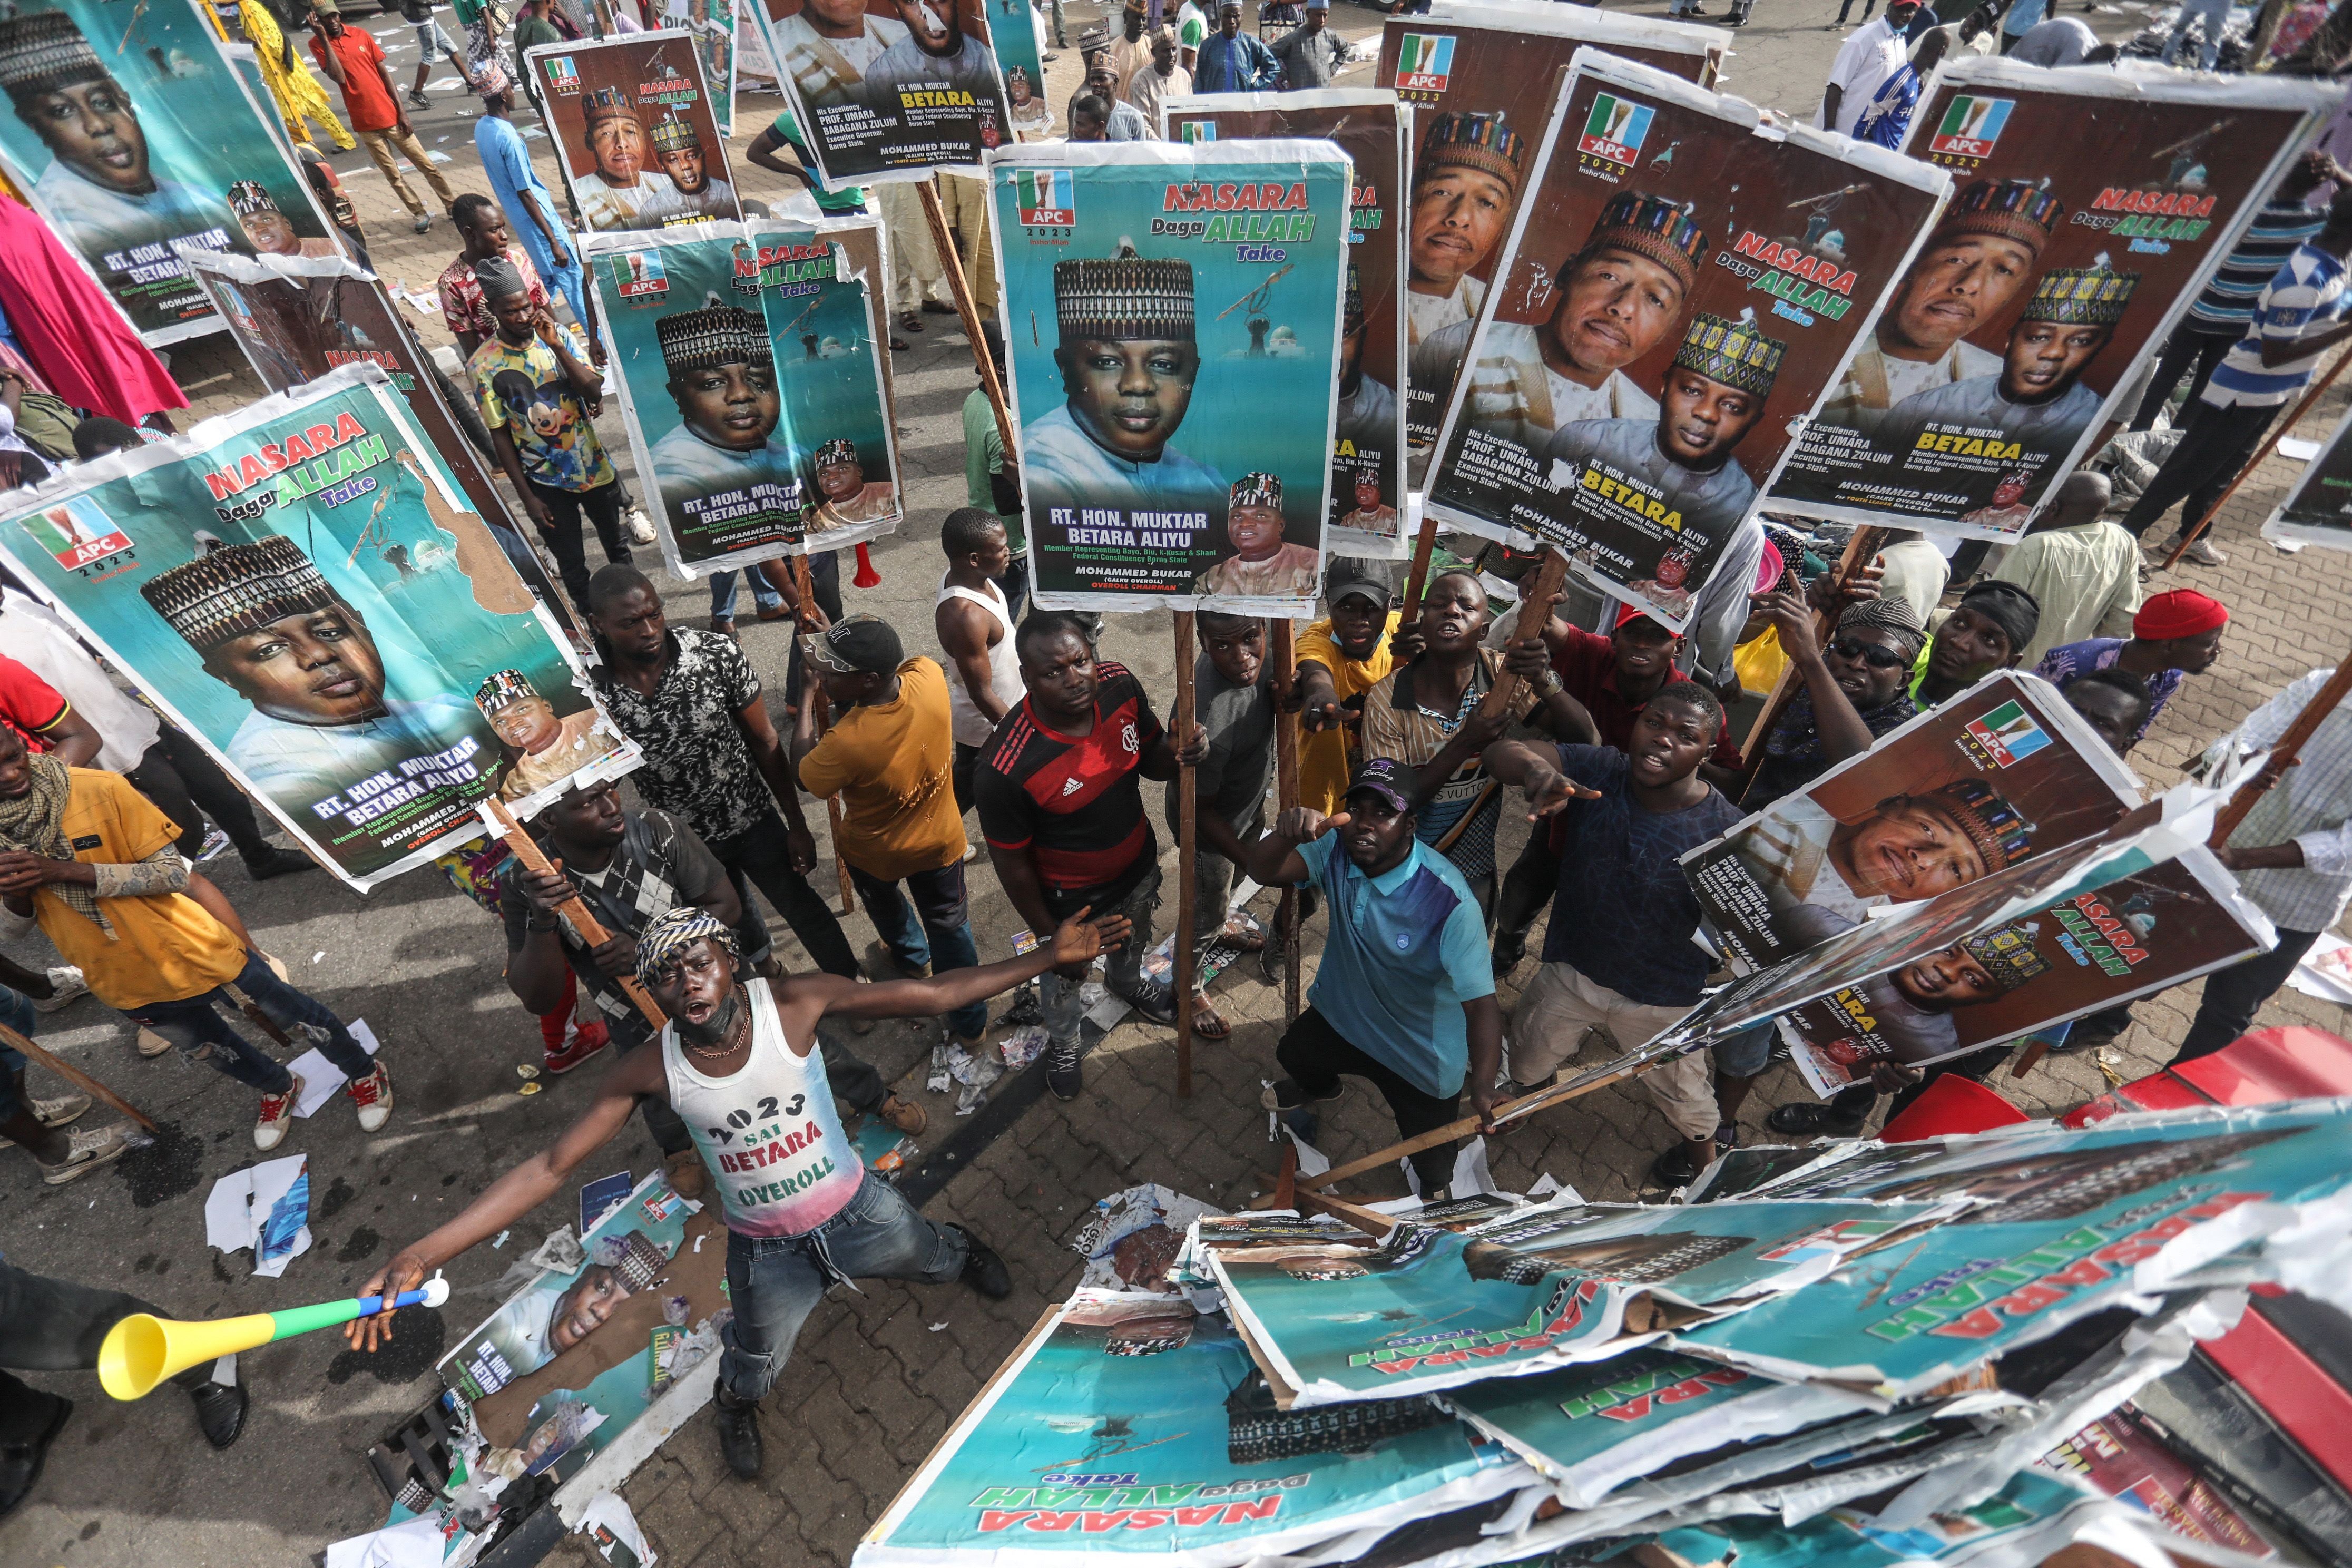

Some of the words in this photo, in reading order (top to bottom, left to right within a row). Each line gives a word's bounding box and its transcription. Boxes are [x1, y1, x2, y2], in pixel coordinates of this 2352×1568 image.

[640, 79, 692, 95] NASARA
[1408, 76, 1437, 87] APC
[639, 96, 658, 104] Daga
[659, 90, 697, 105] ALLAH
[900, 91, 975, 108] BETARA
[1399, 91, 1439, 101] 2023
[819, 114, 844, 125] PROF.
[846, 110, 875, 122] UMARA
[827, 104, 862, 114] Excellency,
[822, 121, 868, 135] BABAGANA
[869, 117, 897, 128] ZULUM
[880, 143, 937, 155] MOHAMMED
[1592, 141, 1626, 160] APC
[1944, 139, 1982, 153] APC
[1580, 154, 1626, 175] 2023
[1931, 154, 1979, 168] 2023
[1579, 166, 1618, 184] Insha'Allah
[1163, 183, 1308, 211] NASARA
[2091, 188, 2217, 217] NASARA
[1033, 211, 1063, 223] APC
[1151, 218, 1203, 237] Daga
[1202, 214, 1316, 242] ALLAH
[2070, 211, 2119, 230] Daga
[2109, 215, 2211, 241] ALLAH
[1027, 228, 1071, 237] 2023
[104, 253, 132, 270] RT.
[130, 244, 171, 263] HON.
[1236, 244, 1287, 262] Take
[1733, 231, 1857, 296] NASARA
[759, 260, 836, 287] ALLAH
[631, 281, 658, 293] APC
[781, 282, 820, 299] Take
[1715, 251, 1760, 279] Daga
[1751, 270, 1852, 321] ALLAH
[626, 293, 667, 304] 2023
[1771, 300, 1814, 327] Take
[1468, 429, 1482, 439] His
[1483, 433, 1528, 456] Excellency,
[1828, 435, 1870, 449] UMARA
[1925, 423, 1937, 432] RT.
[1940, 424, 1962, 435] HON.
[1964, 428, 2003, 439] MUKTAR
[204, 411, 367, 501] NASARA
[1359, 450, 1380, 459] ALIYU
[1464, 438, 1495, 456] PROF.
[1499, 448, 1539, 473] UMARA
[1851, 450, 1893, 464] ZULUM
[1915, 433, 2021, 459] BETARA
[2021, 453, 2049, 463] ALIYU
[214, 492, 274, 522] Daga
[277, 434, 390, 509] ALLAH
[1454, 468, 1477, 482] Borno
[1479, 477, 1502, 490] State.
[1457, 460, 1495, 478] Executive
[1497, 474, 1533, 495] Governor,
[1460, 449, 1521, 478] BABAGANA
[1522, 471, 1561, 495] ZULUM
[1589, 459, 1601, 471] RT.
[1604, 466, 1624, 482] HON.
[1626, 476, 1664, 501] MUKTAR
[319, 477, 377, 509] Take
[683, 499, 707, 514] RT.
[710, 490, 748, 507] HON.
[751, 478, 802, 498] MUKTAR
[701, 502, 758, 524] BETARA
[762, 498, 800, 512] ALIYU
[1051, 508, 1076, 524] RT.
[1082, 509, 1125, 527] HON.
[1131, 512, 1207, 528] MUKTAR
[1571, 500, 1590, 513] Borno
[1590, 509, 1606, 521] State
[1581, 496, 1598, 508] Shani
[1599, 506, 1622, 521] Federal
[1622, 517, 1663, 542] Constituency
[1582, 469, 1681, 533] BETARA
[1682, 528, 1708, 546] ALIYU
[1577, 487, 1603, 503] Member
[1604, 499, 1644, 524] Representing
[1677, 537, 1701, 553] K-Kusar
[1068, 528, 1135, 546] BETARA
[1141, 532, 1191, 547] ALIYU
[1511, 504, 1588, 544] MOHAMMED
[1589, 542, 1634, 569] BUKAR
[76, 538, 116, 562] APC
[1075, 546, 1121, 554] Representing
[1101, 554, 1145, 563] Constituency
[79, 551, 135, 577] 2023
[1075, 567, 1148, 577] MOHAMMED
[803, 645, 813, 653] M
[1954, 739, 1984, 771] Insha'Allah
[1960, 733, 1996, 768] 2023
[1977, 733, 2006, 757] APC
[313, 796, 350, 819] RT.
[347, 771, 403, 803] HON.
[399, 737, 478, 777] MUKTAR
[1360, 769, 1394, 781] Racing
[345, 780, 426, 826] BETARA
[425, 762, 477, 789] ALIYU
[1063, 782, 1083, 796] adidas
[1718, 859, 1742, 886] PROF.
[1741, 885, 1772, 921] UMARA
[1709, 864, 1752, 914] BABAGANA
[1749, 914, 1780, 947] ZULUM
[2051, 910, 2131, 976] ALLAH
[2055, 933, 2089, 966] Take
[1870, 1033, 1892, 1053] ALIYU
[708, 1094, 806, 1145] 2023
[719, 1120, 823, 1173] BETARA
[744, 1123, 782, 1147] SAI
[738, 1156, 835, 1207] OVEROLL
[649, 1203, 663, 1217] APC
[1865, 1226, 2109, 1343] ALLAH
[477, 1340, 496, 1361] RT.
[489, 1354, 512, 1383] HON.
[1042, 1473, 1140, 1486] Take
[1200, 1474, 1311, 1498] Daga
[969, 1482, 1206, 1507] ALLAH
[978, 1495, 1284, 1533] NASARA
